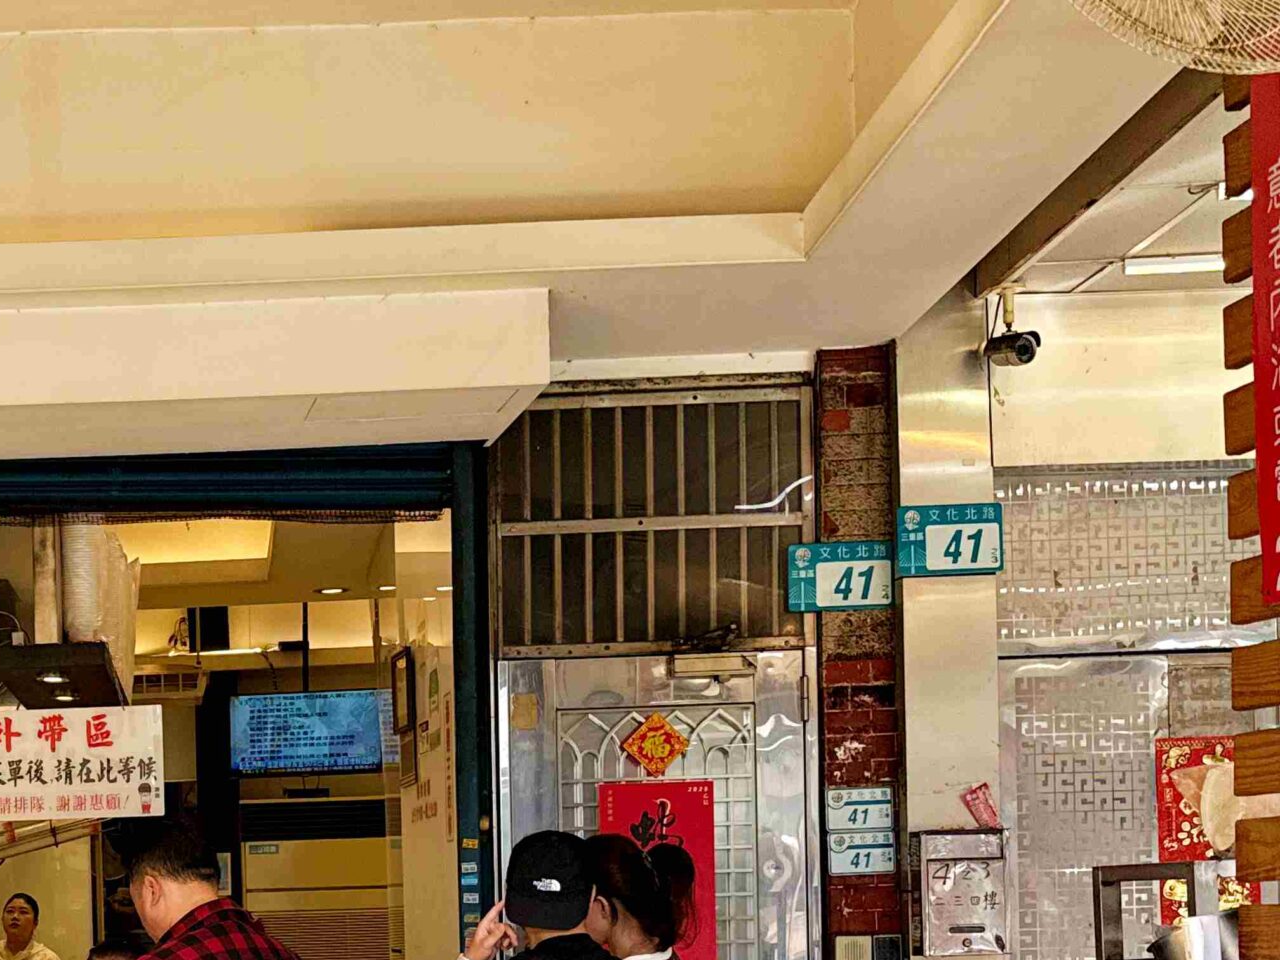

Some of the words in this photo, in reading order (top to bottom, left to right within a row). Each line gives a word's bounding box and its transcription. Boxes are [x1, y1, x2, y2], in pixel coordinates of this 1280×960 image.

[928, 507, 995, 521] 文化北路
[819, 544, 886, 559] 文化北路
[944, 529, 983, 564] 41
[834, 566, 875, 600] 41
[642, 731, 672, 758] 福
[848, 808, 869, 824] 41
[851, 851, 871, 868] 41
